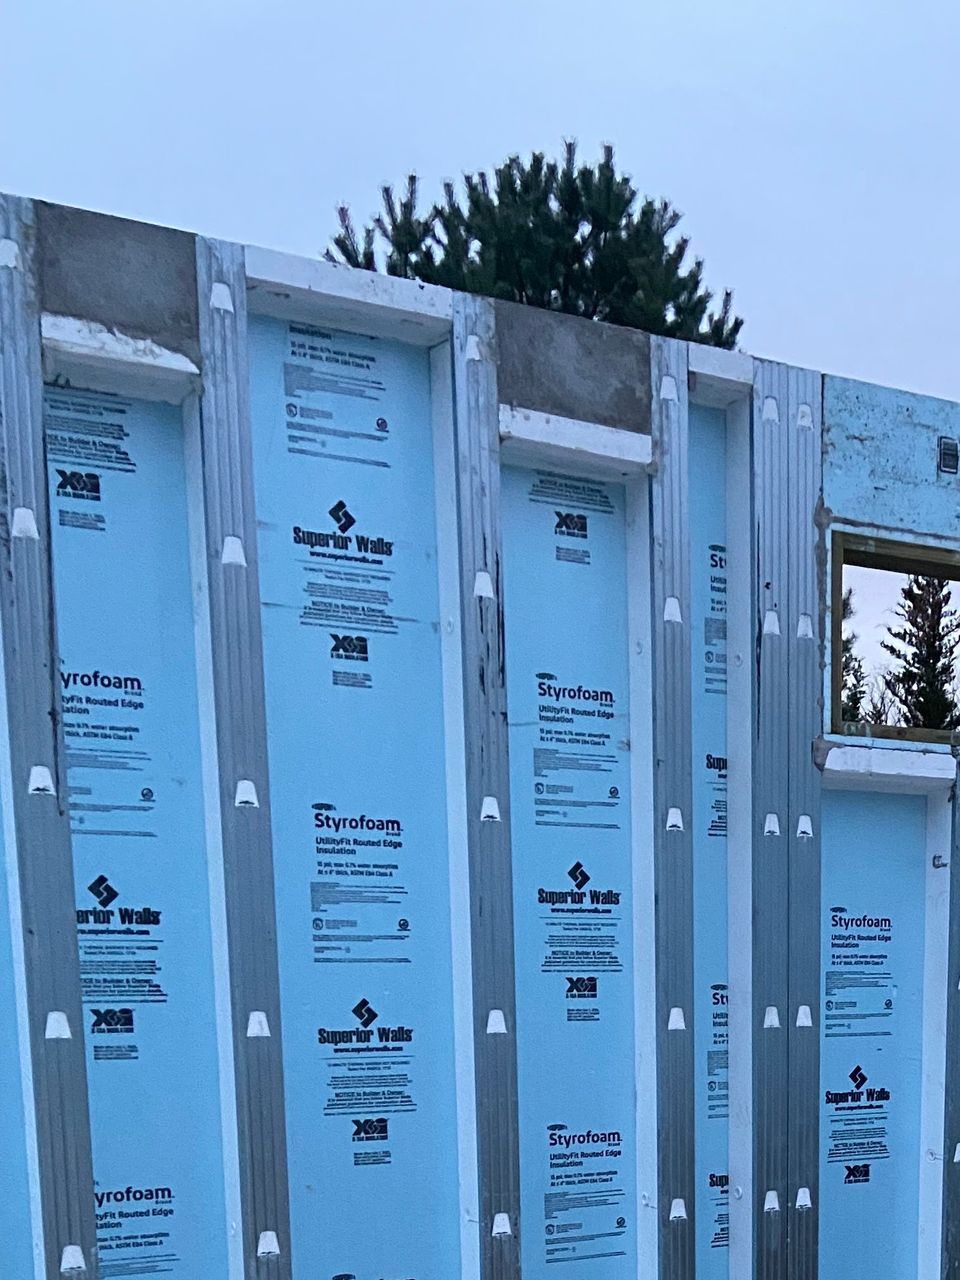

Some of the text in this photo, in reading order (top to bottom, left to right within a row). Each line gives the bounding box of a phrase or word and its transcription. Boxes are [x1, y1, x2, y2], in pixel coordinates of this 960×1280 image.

[293, 527, 393, 556] Superior Walls
[60, 671, 141, 690] yrofoam
[538, 682, 613, 702] Styrofoam
[61, 705, 89, 715] lation
[85, 696, 118, 708] Routed
[121, 699, 144, 710] Edge
[539, 705, 614, 719] UtilityFit Routed Edge
[539, 714, 574, 724] Insulation
[314, 813, 400, 832] Styrofoam
[316, 837, 402, 849] UtilityFit Routed Edge
[316, 847, 356, 855] Insulation
[538, 888, 620, 906] Superior Walls
[76, 907, 160, 925] erior Walls
[831, 915, 891, 930] Styrofoam
[878, 934, 892, 942] Edge
[318, 1027, 412, 1045] Superior Walls
[826, 1088, 890, 1105] Superior Walls
[549, 1130, 621, 1148] Styrofoam
[550, 1149, 622, 1161] UtilityFit Routed Edge
[550, 1160, 583, 1169] Insulation
[94, 1186, 171, 1208] yrofoam
[118, 1209, 150, 1219] Routed
[152, 1208, 173, 1216] Edge
[96, 1221, 122, 1229] lation
